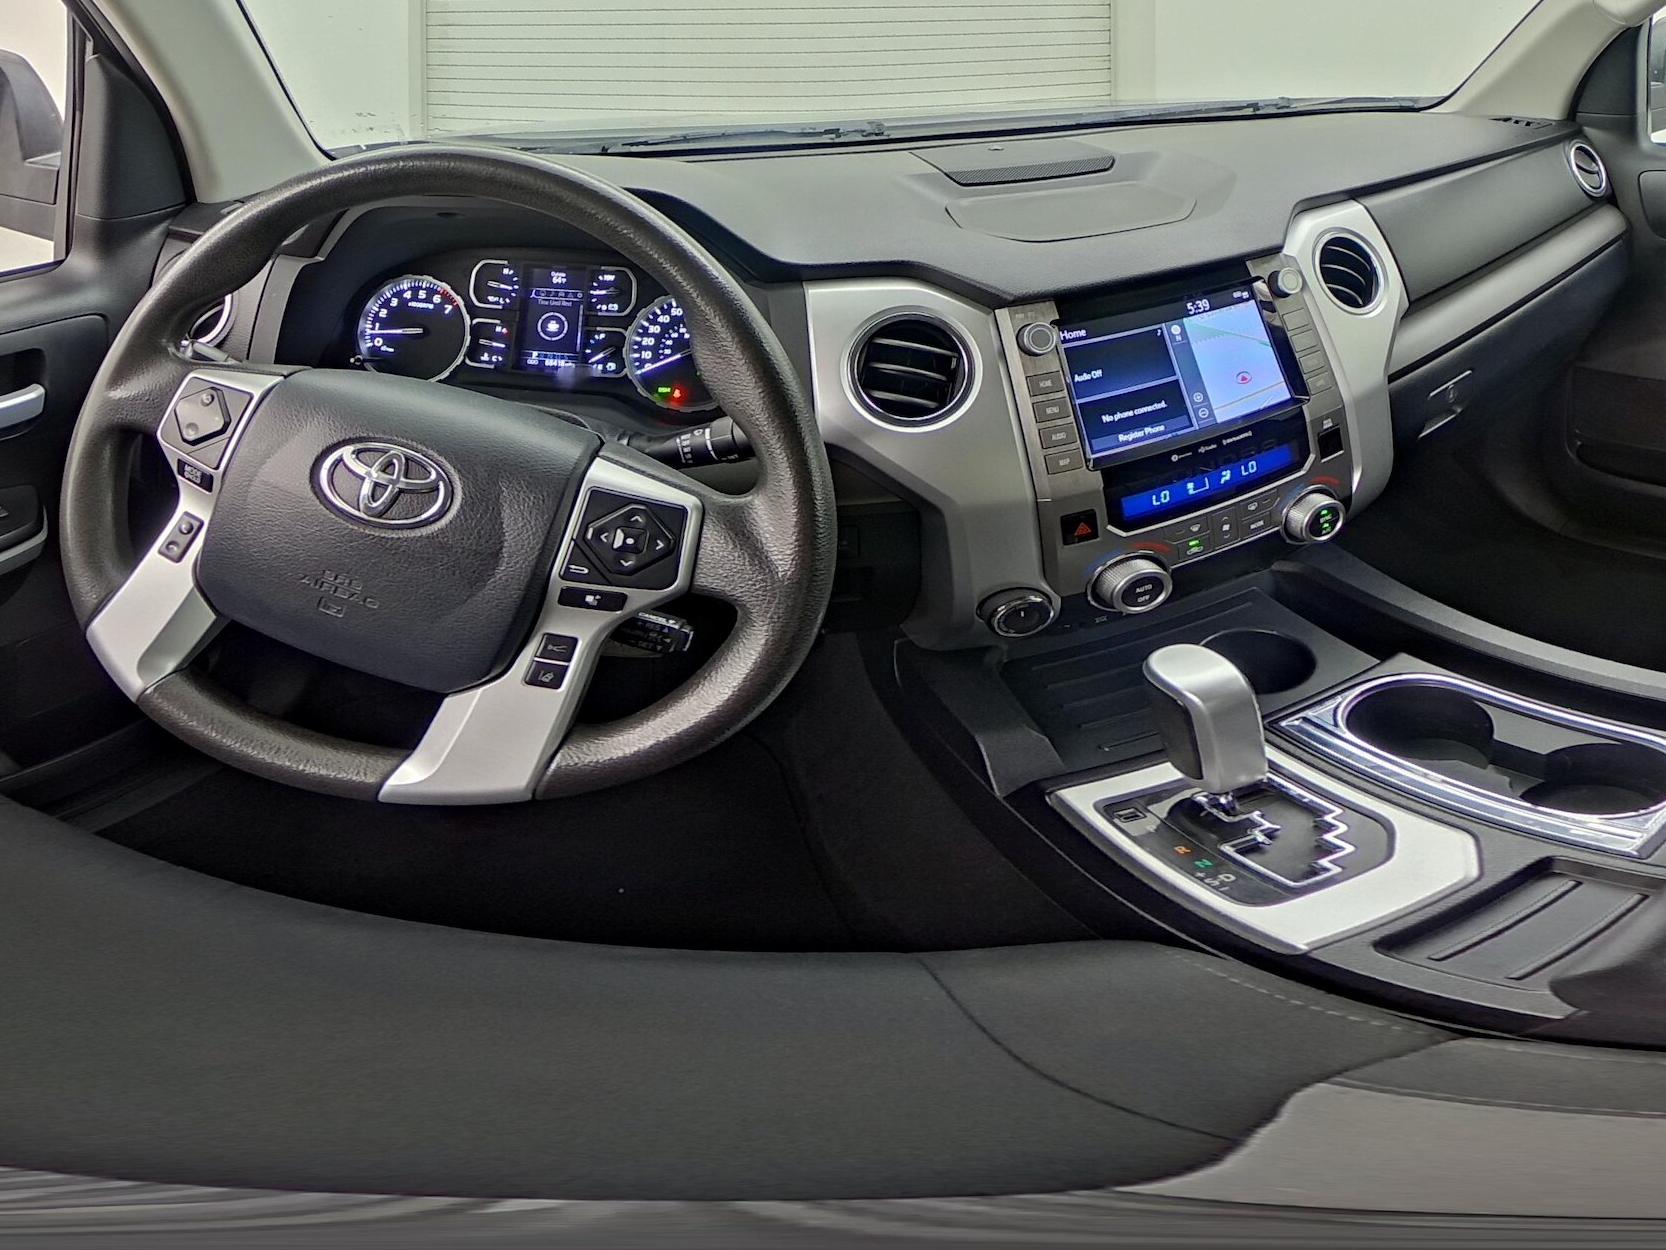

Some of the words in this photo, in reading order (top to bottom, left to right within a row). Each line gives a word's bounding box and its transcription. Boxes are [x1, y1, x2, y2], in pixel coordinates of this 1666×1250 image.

[403, 291, 411, 300] 4
[418, 290, 427, 298] 5
[390, 298, 399, 307] 3
[433, 295, 441, 303] 6
[444, 305, 453, 314] 7
[1187, 299, 1209, 315] 5:39
[379, 309, 387, 318] 2
[671, 308, 683, 316] 50
[657, 315, 670, 323] 40
[1060, 328, 1087, 340] Home
[374, 338, 383, 346] 0
[641, 338, 655, 346] 20
[641, 351, 651, 359] 10
[1074, 372, 1092, 382] Audio
[1092, 369, 1103, 378] Off
[1039, 379, 1053, 387] HOME
[1046, 406, 1059, 414] MENU
[1101, 414, 1113, 423] No
[1114, 410, 1133, 422] phone
[1134, 400, 1167, 416] connected.
[1051, 432, 1067, 440] AUDIO
[1119, 430, 1145, 443] Register
[1145, 424, 1165, 436] Phone
[1059, 458, 1071, 466] MAP
[1241, 460, 1257, 476] LO
[1152, 490, 1170, 506] LO
[1250, 520, 1264, 530] MODE
[300, 575, 381, 609] AIRBAG
[1135, 583, 1153, 594] AUTO
[1137, 594, 1151, 603] OFF
[638, 612, 667, 624] CANCEL
[1174, 846, 1191, 854] R
[1195, 859, 1213, 868] N
[1204, 878, 1221, 886] S
[1219, 873, 1236, 882] D
